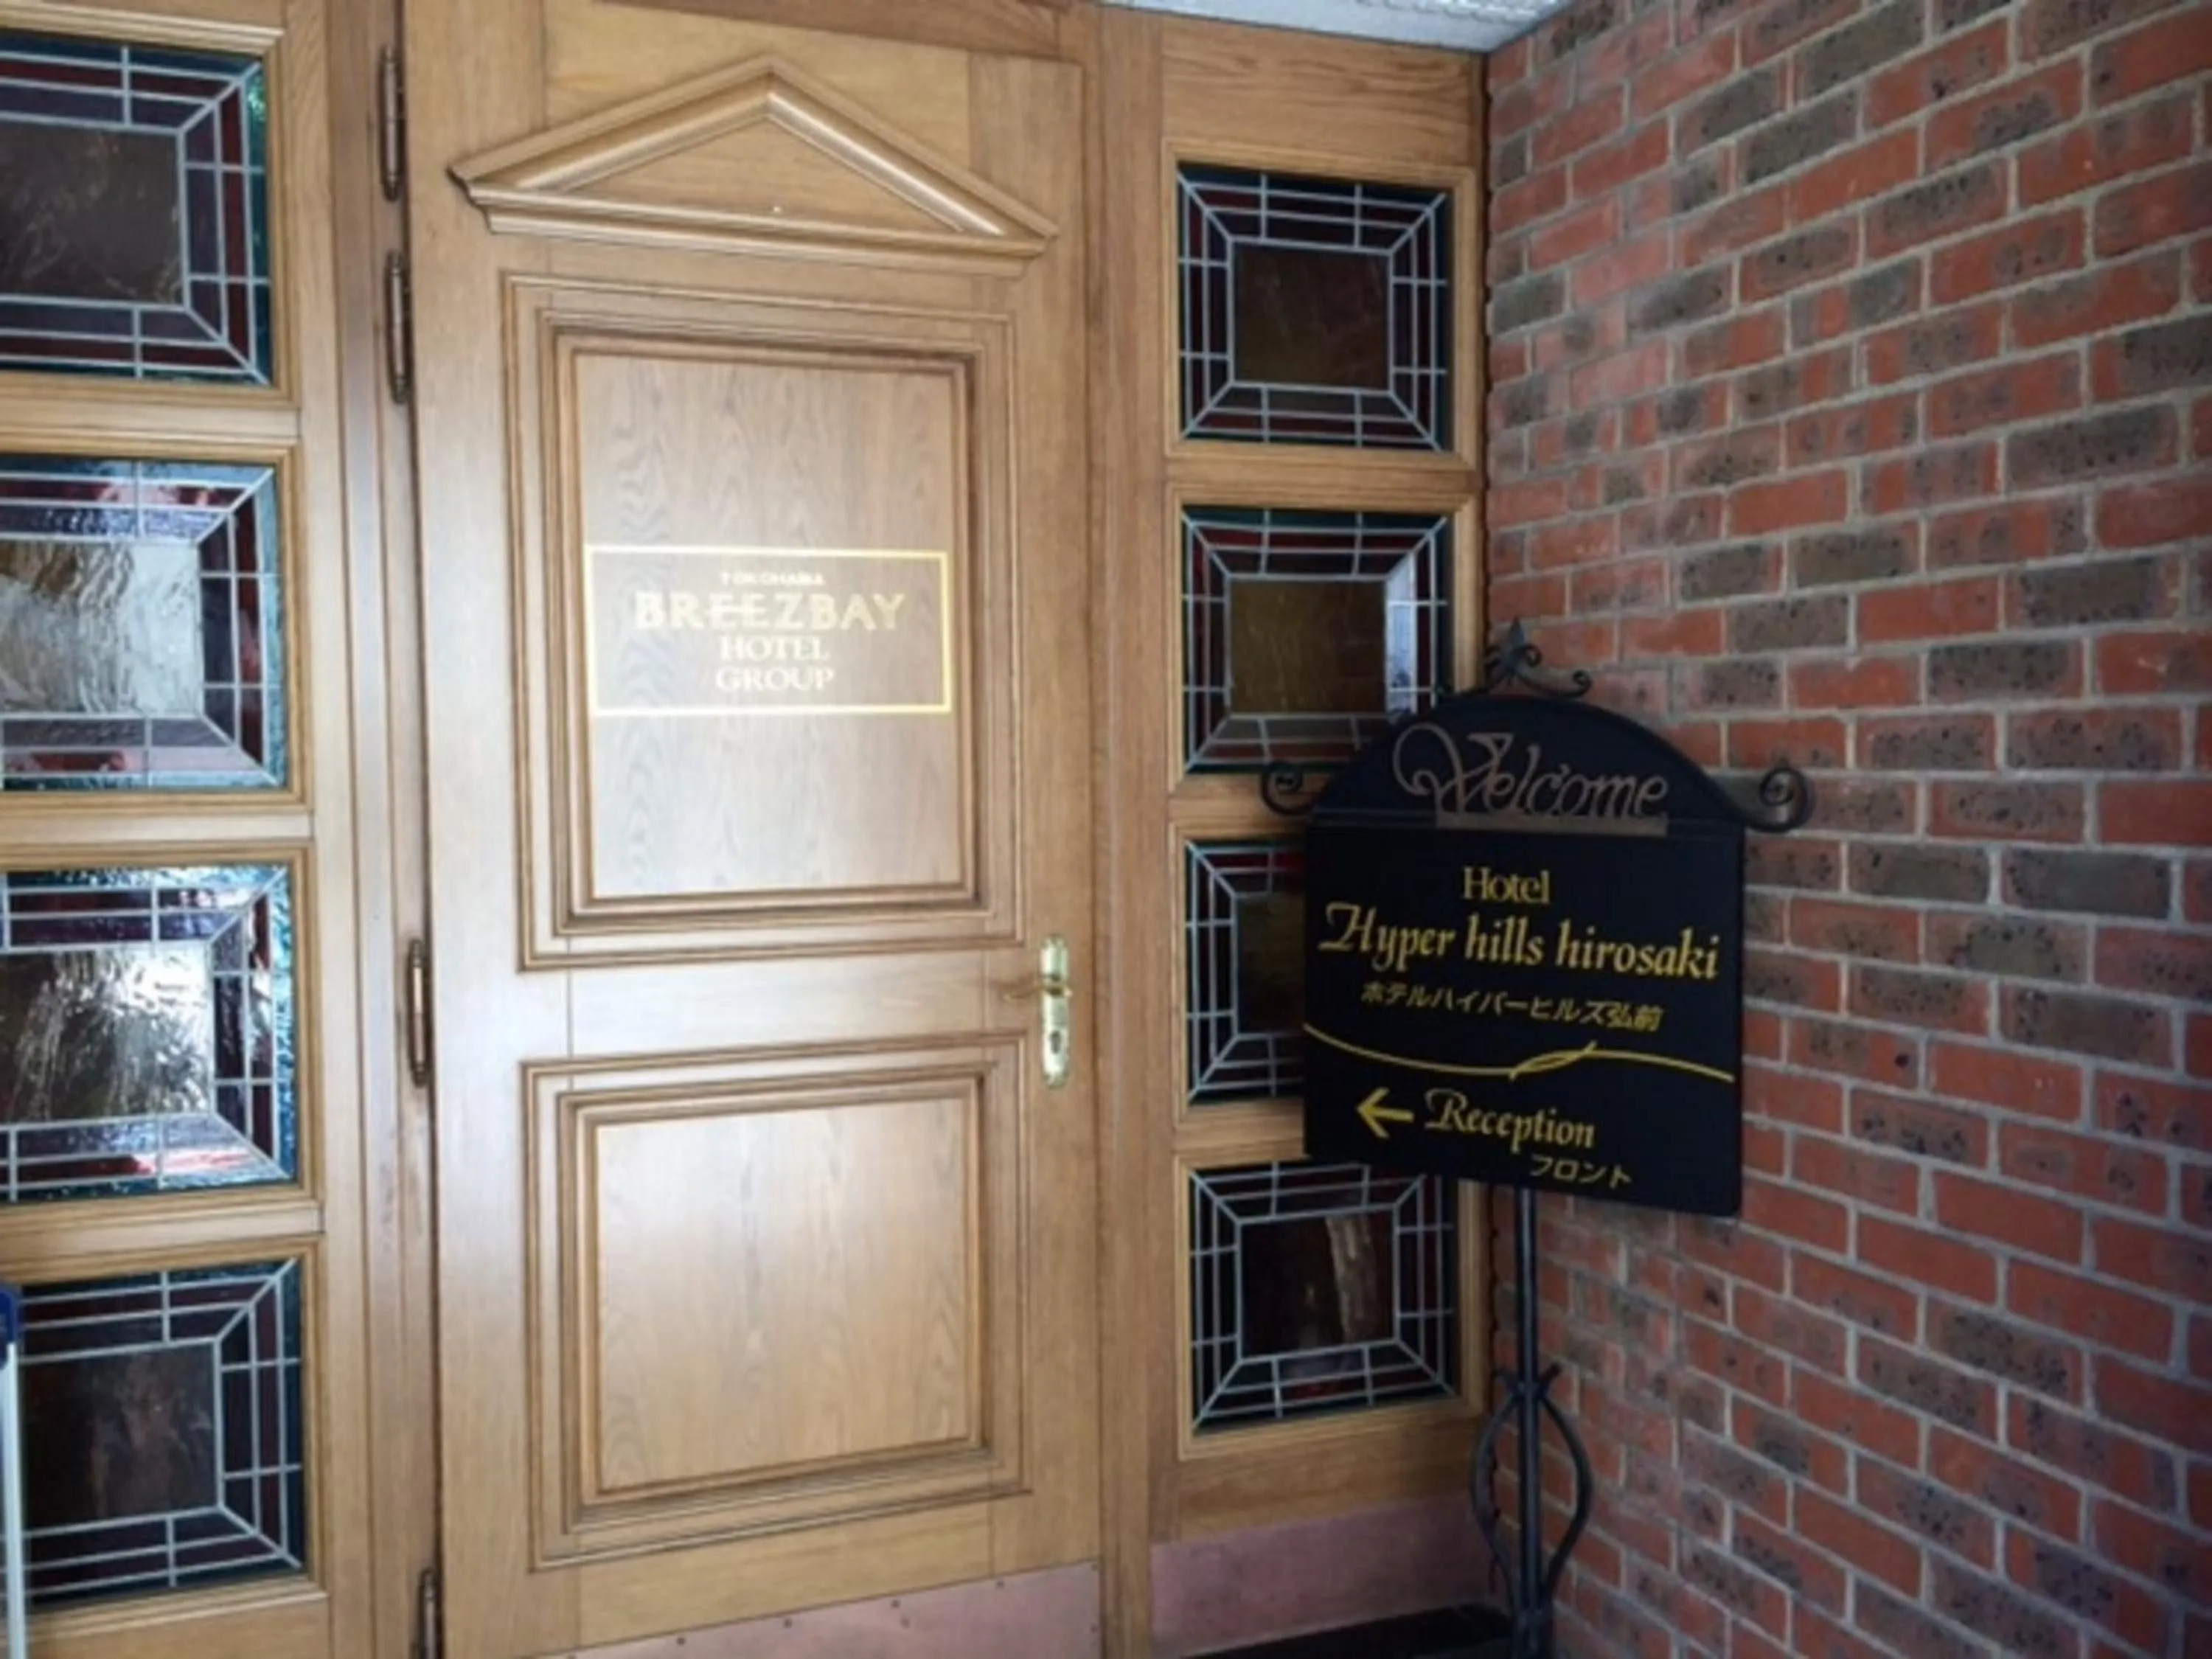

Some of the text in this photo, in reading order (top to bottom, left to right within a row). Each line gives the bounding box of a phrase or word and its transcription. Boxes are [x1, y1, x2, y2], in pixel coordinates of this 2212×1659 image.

[634, 591, 905, 631] BREEZBAY
[719, 635, 827, 661] HOTEL
[714, 665, 834, 692] GROUP
[1393, 722, 1669, 820] Welcome
[1461, 866, 1551, 905] Hotel
[1318, 901, 1720, 981] Hyper hills hirosaki
[1423, 1088, 1596, 1154] Reception
[1528, 1155, 1632, 1189] フロント
